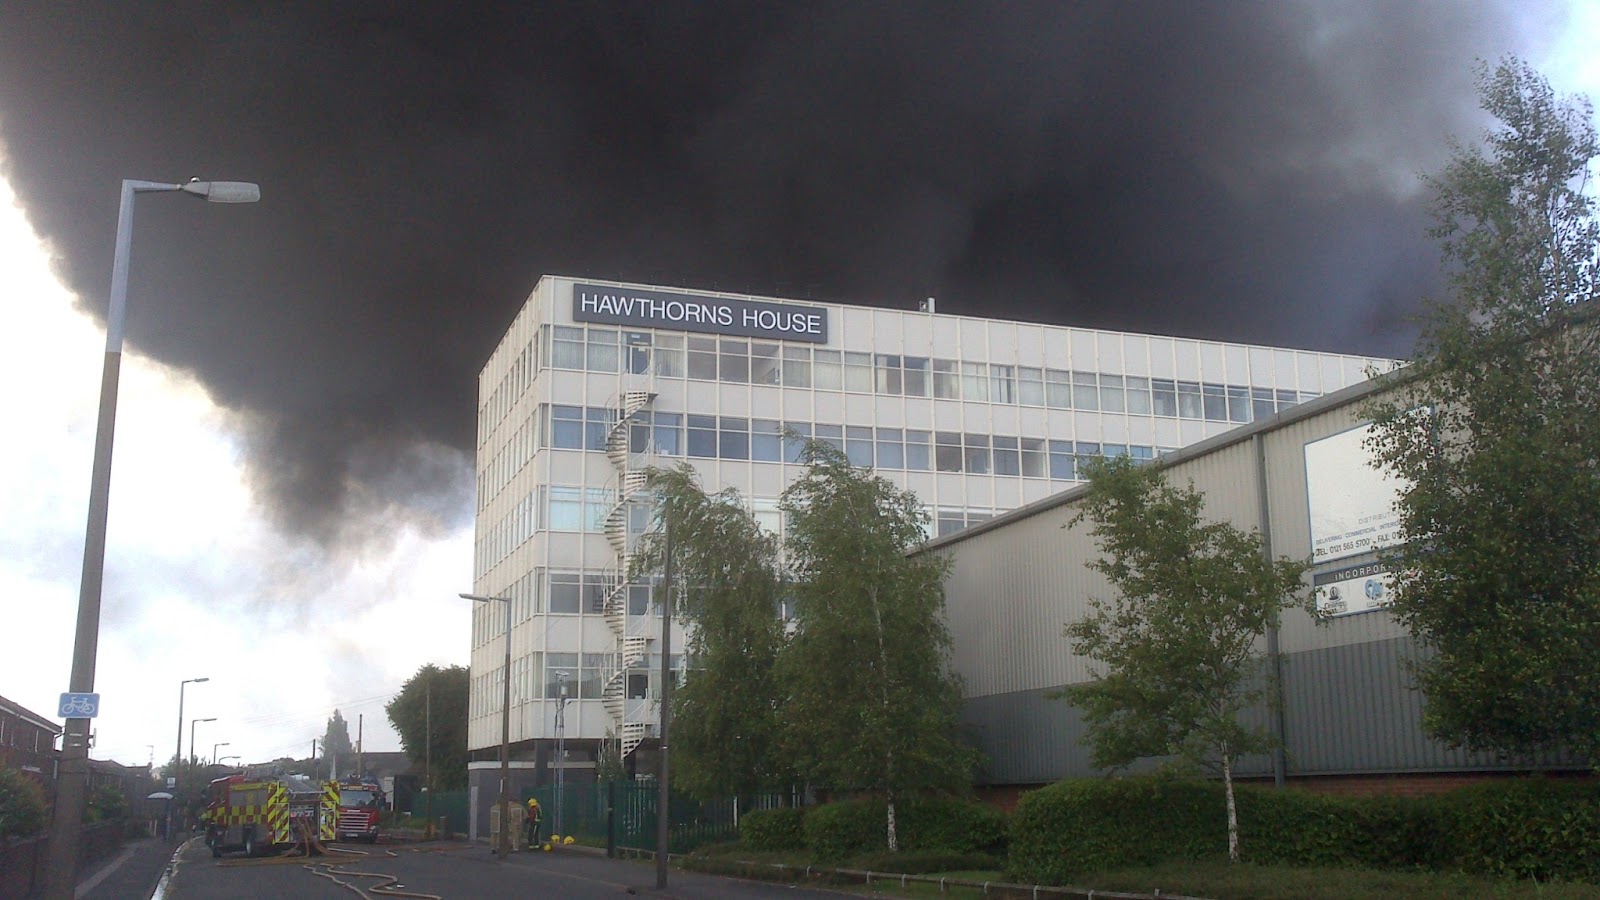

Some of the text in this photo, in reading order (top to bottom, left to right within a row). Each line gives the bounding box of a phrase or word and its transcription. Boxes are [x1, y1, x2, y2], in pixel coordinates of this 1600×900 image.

[580, 292, 822, 335] HAWTHORNS HOUSE
[1358, 511, 1400, 524] DISTRIBUTIO
[1316, 535, 1342, 545] DELIVERING
[1345, 527, 1376, 537] COMMERCIAL
[1329, 544, 1342, 554] 0121
[1343, 542, 1354, 551] 565
[1355, 537, 1370, 548] 5700
[1334, 564, 1386, 580] INCORPOR
